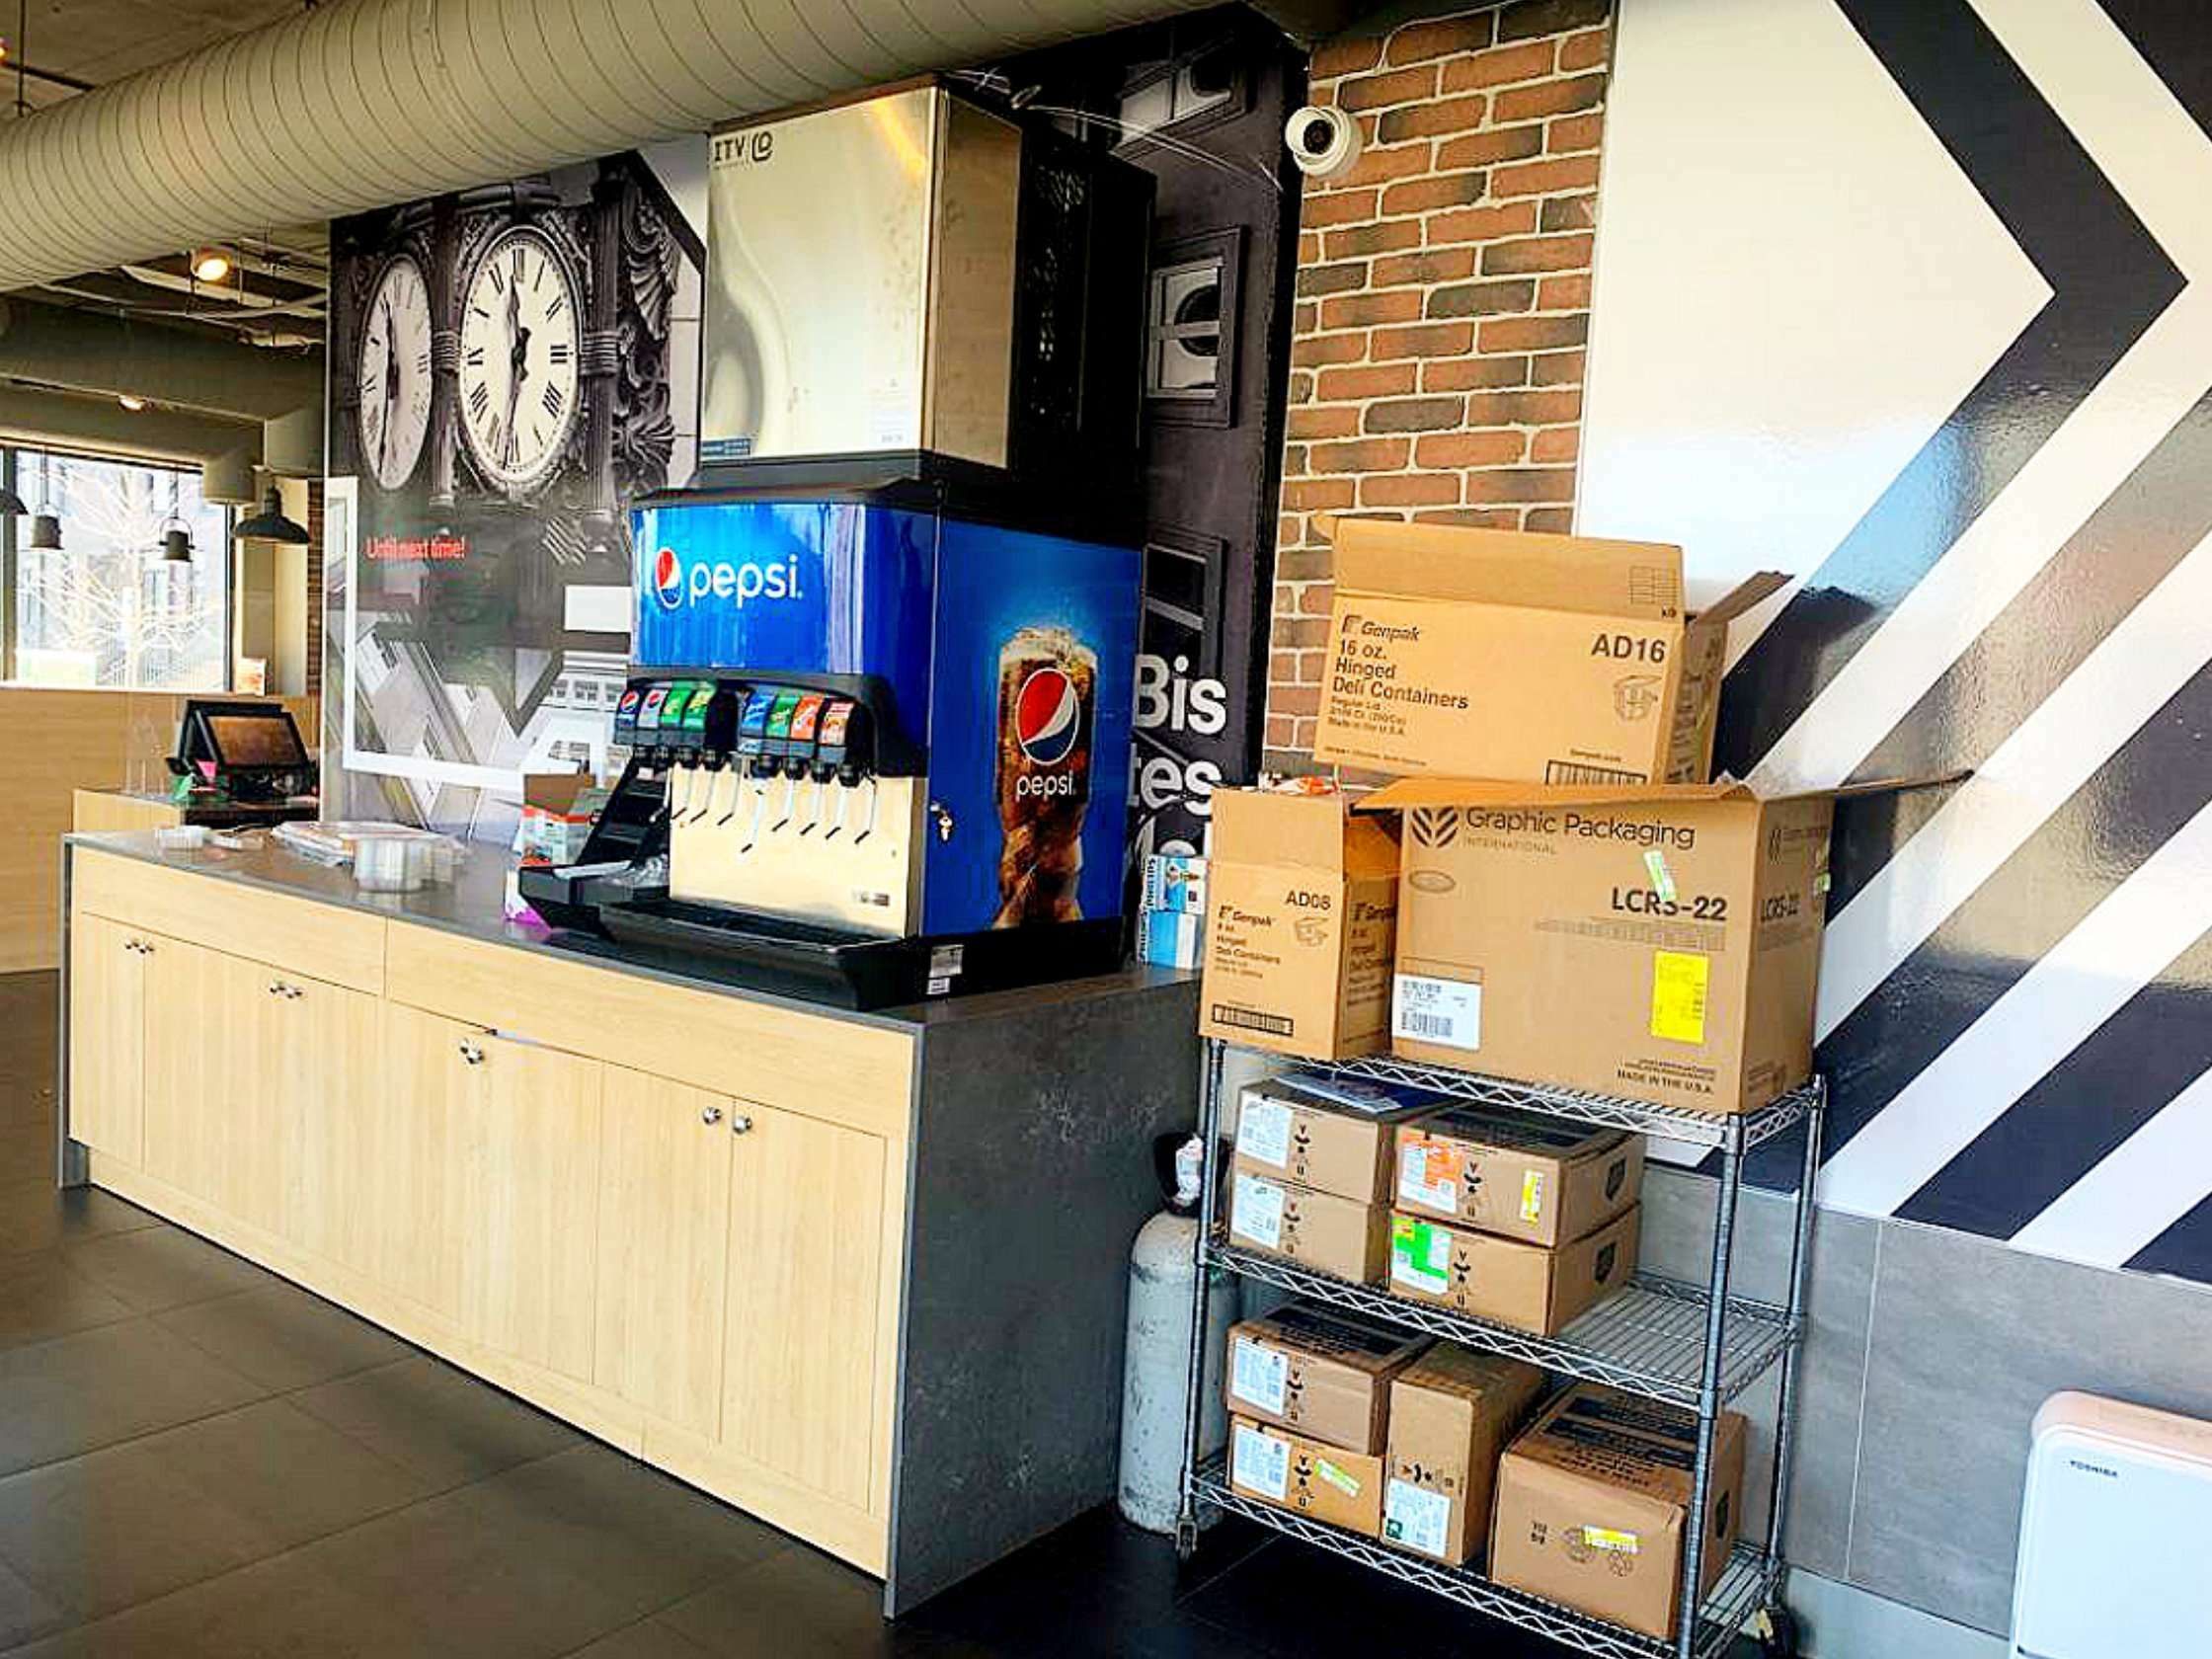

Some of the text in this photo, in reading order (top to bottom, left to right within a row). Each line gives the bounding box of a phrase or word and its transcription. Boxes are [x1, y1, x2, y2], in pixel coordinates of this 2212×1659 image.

[689, 553, 800, 609] pepsi
[1361, 620, 1420, 643] Genpak
[1340, 639, 1387, 660] 16 oz.
[1590, 633, 1667, 664] AD16
[1335, 657, 1397, 679] Hinged
[1333, 676, 1469, 710] Deli Containers
[1015, 769, 1073, 802] pepsi
[1466, 806, 1696, 850] Graphic Packaging
[1463, 835, 1557, 856] INTERNATIONAL
[1612, 887, 1727, 921] LCRS-22
[2069, 1460, 2118, 1478] TOSHIBA
